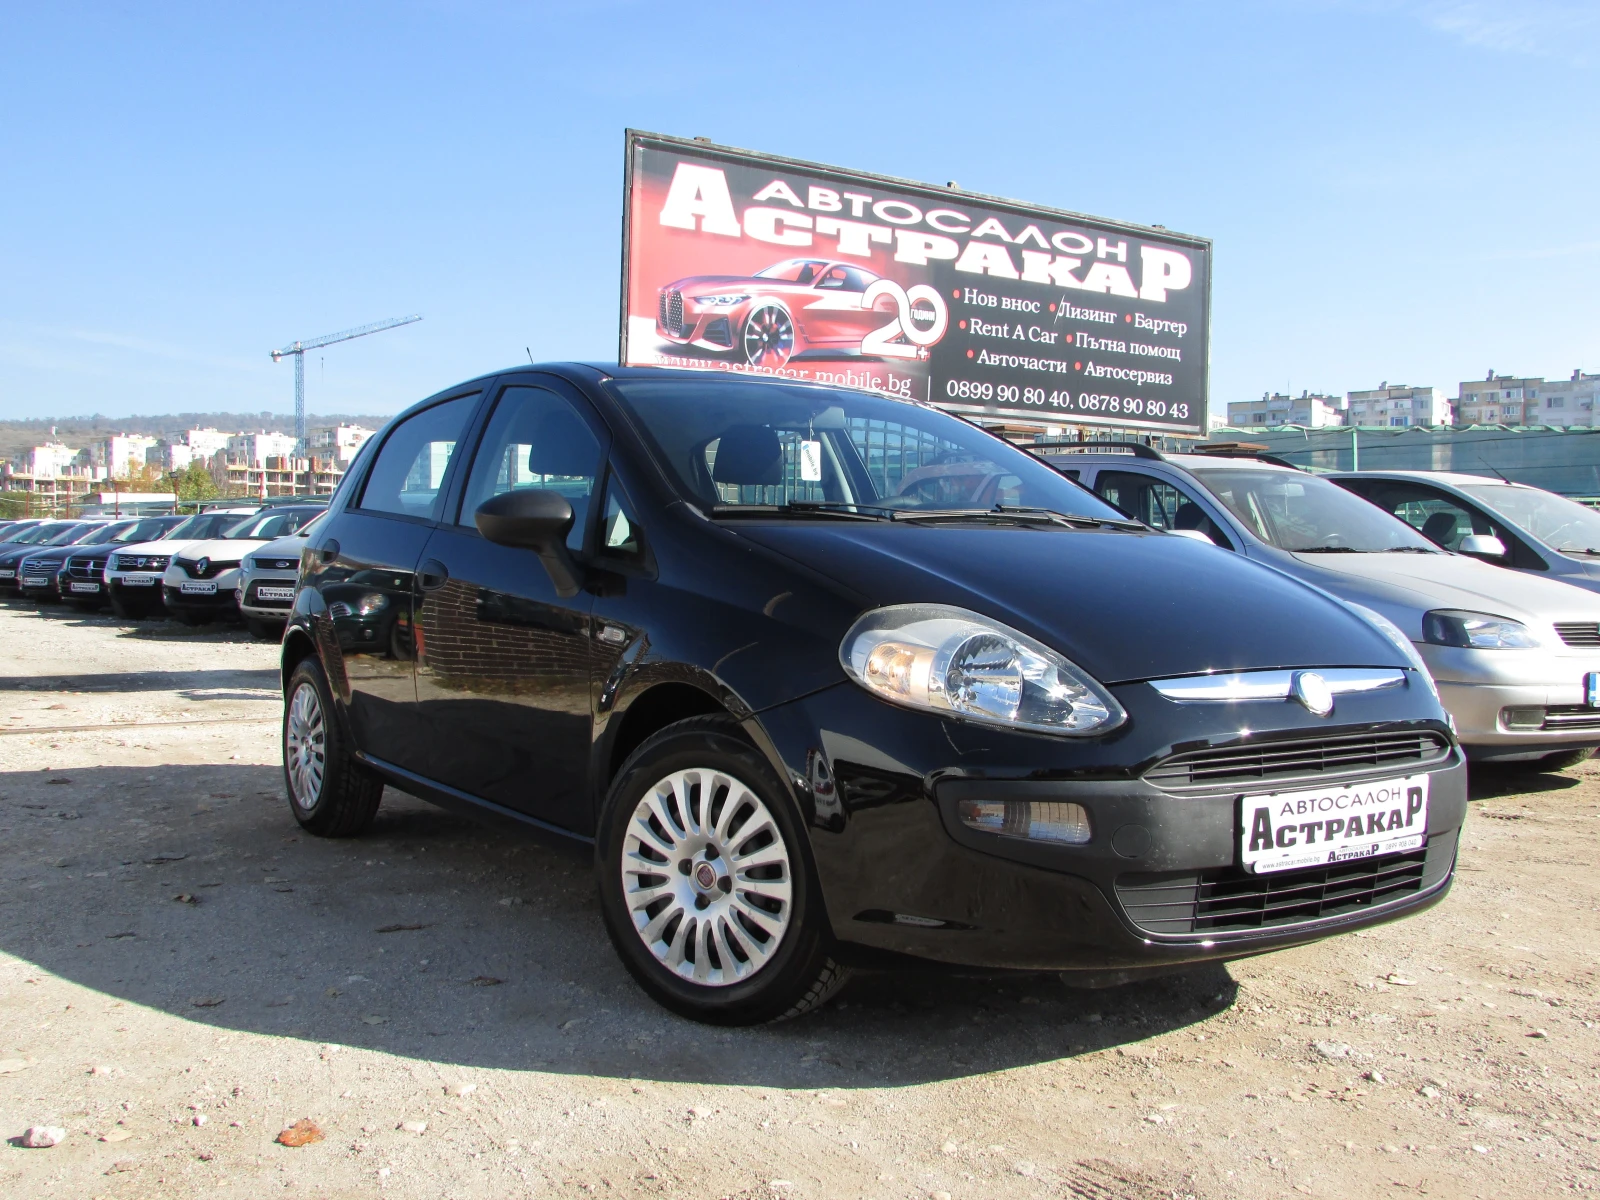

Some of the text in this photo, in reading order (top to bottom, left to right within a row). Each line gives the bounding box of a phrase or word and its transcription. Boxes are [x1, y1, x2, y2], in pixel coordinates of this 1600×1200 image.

[659, 161, 1192, 303] АСТРАКАР
[753, 179, 1127, 263] АВТОСАЛОН
[963, 287, 1188, 338] Нов внос Лизинг Бартер
[969, 318, 1182, 363] Rent A Car Пътна помощ
[653, 354, 912, 398] wwwastracarmobile.bg
[976, 349, 1174, 386] Авточасти Автосервиз
[946, 379, 1190, 419] 0899 90 80 40, 0878 90 80 43
[259, 588, 294, 598] АСТРАКА
[1248, 786, 1423, 852] АСТРАКАР
[1279, 786, 1401, 817] АВТОСАЛОН
[1327, 843, 1380, 863] АСТРАКАР
